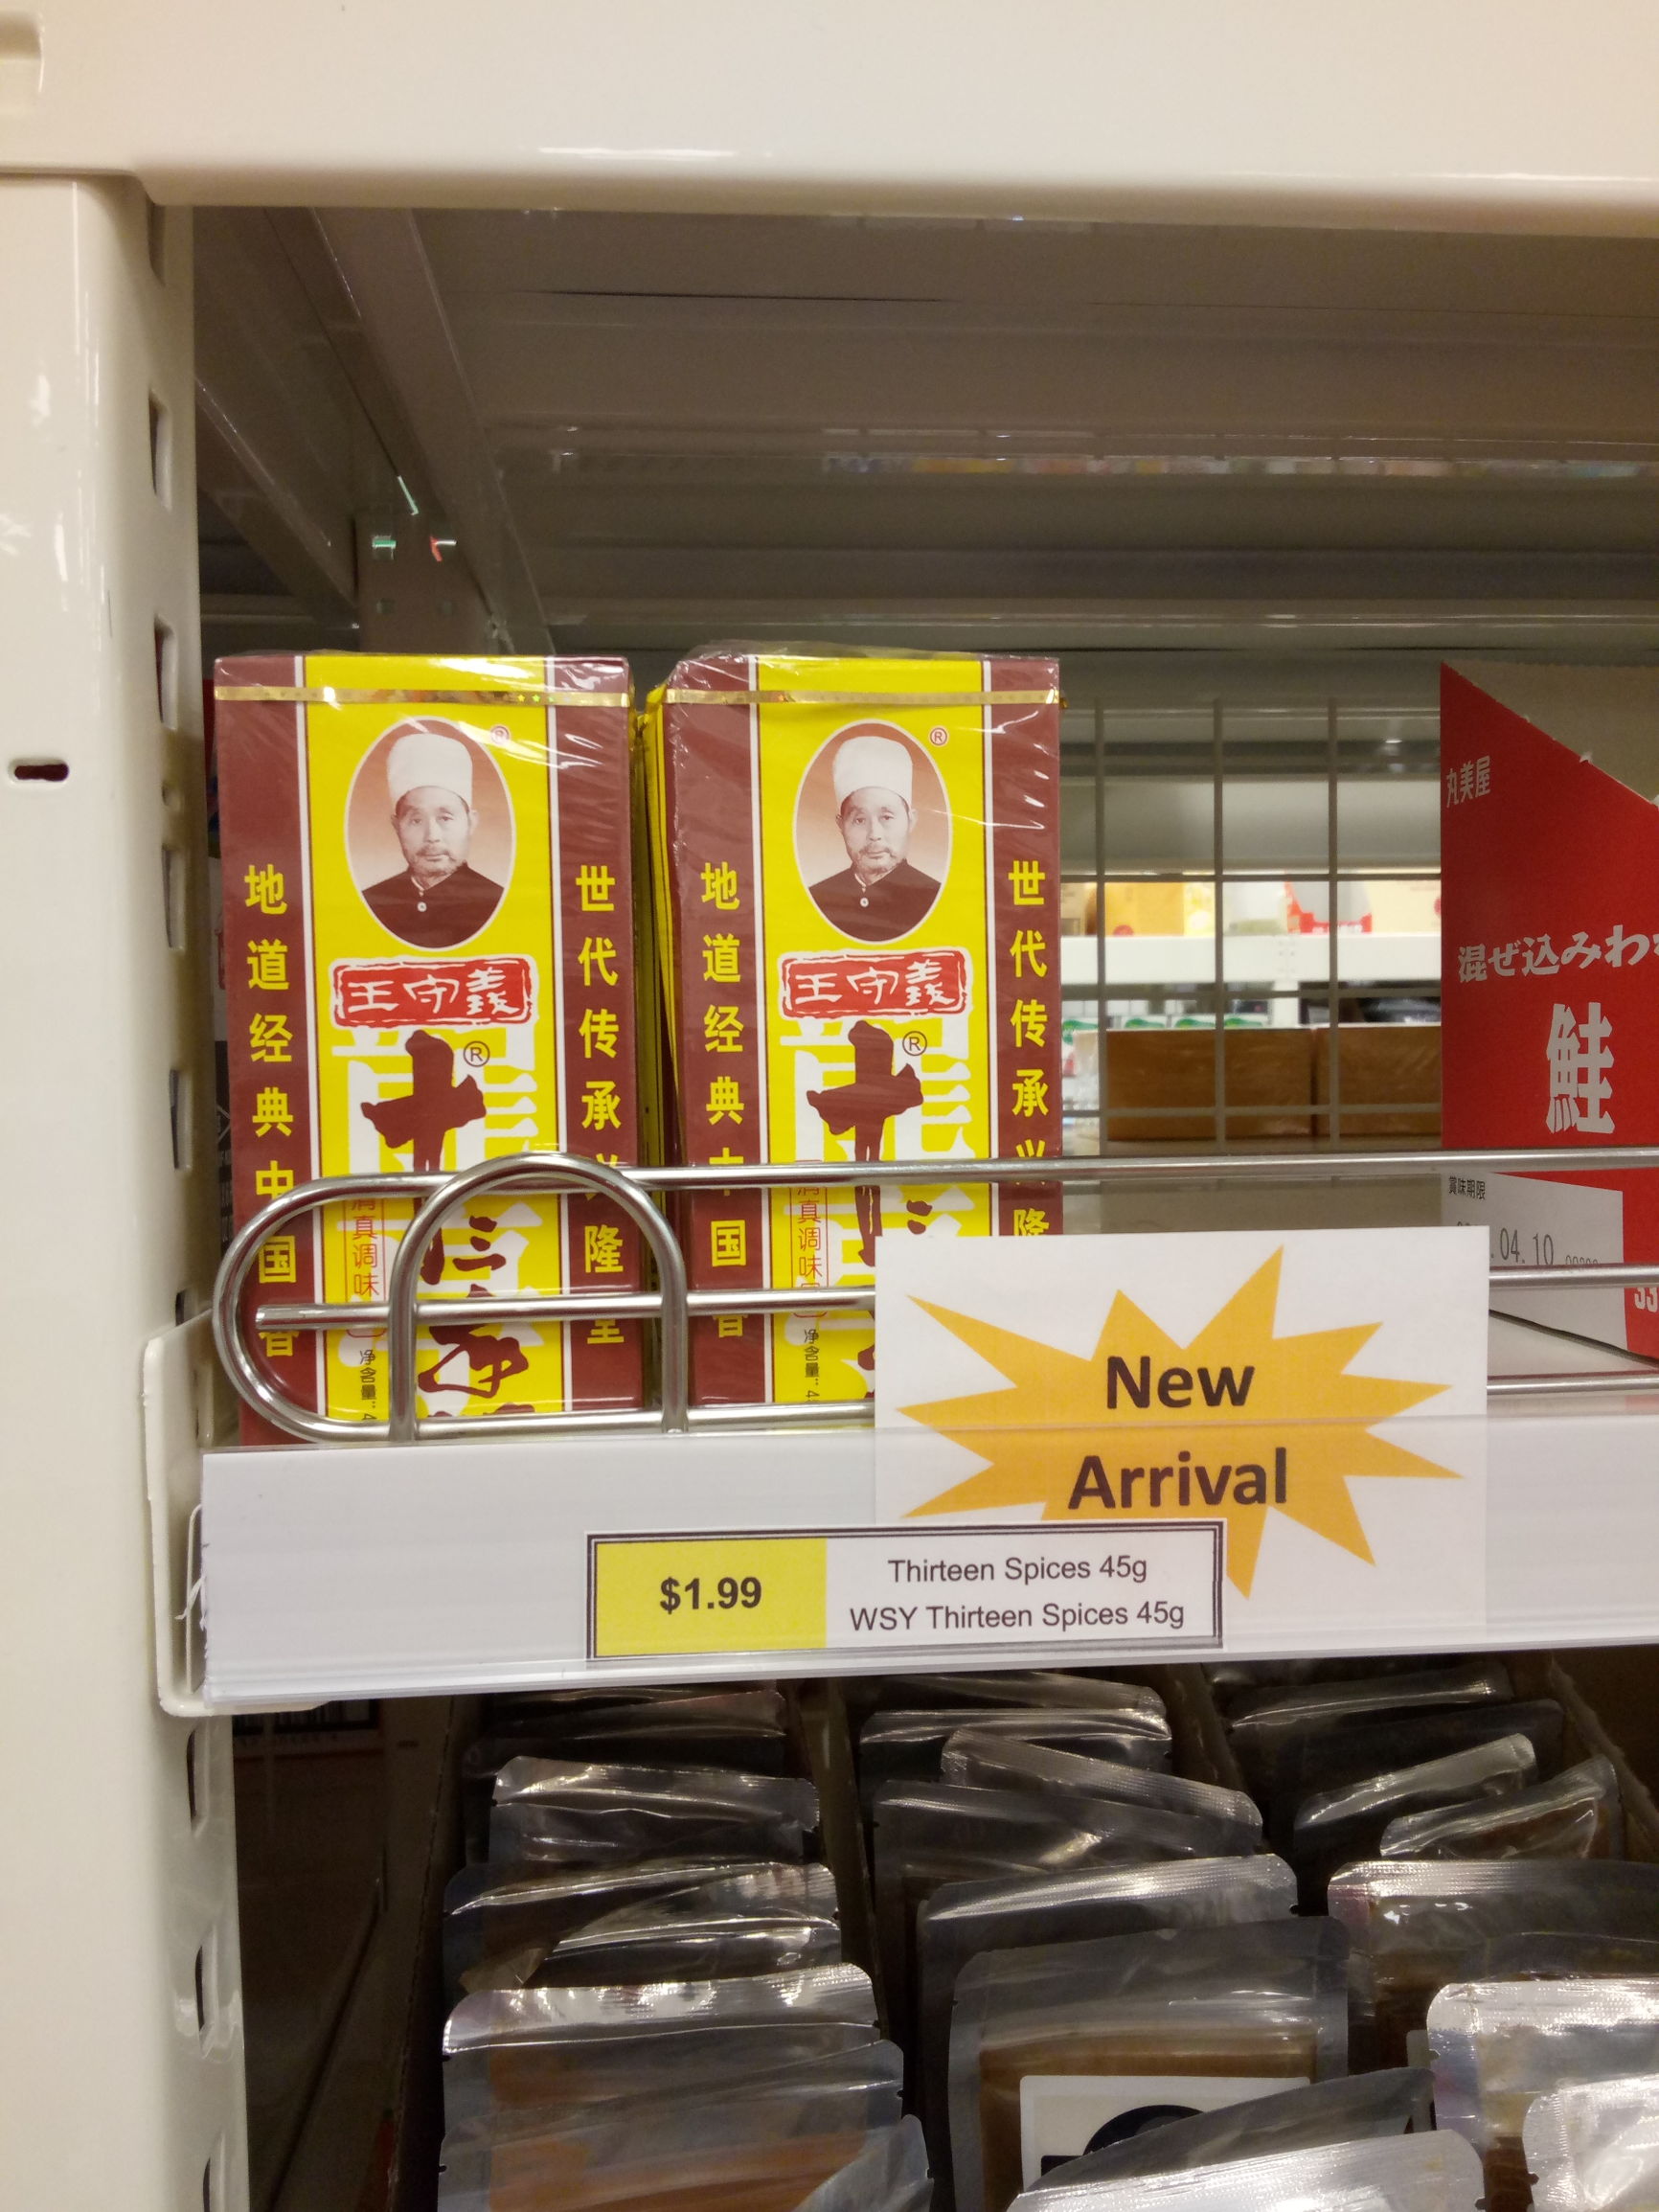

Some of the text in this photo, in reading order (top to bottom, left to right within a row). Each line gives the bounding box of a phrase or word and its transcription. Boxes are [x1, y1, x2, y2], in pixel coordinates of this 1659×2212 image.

[1445, 756, 1491, 808] 丸美屋
[1458, 924, 1659, 983] 混ぜ込みわ
[1545, 1002, 1616, 1134] 鮭
[797, 1187, 823, 1287] 真调味
[1106, 1356, 1255, 1409] New
[1068, 1447, 1286, 1510] Arrival
[659, 1576, 762, 1615] $1.99
[888, 1555, 1148, 1585] Thirteen Spices 45g
[851, 1601, 1185, 1632] WSY Thirteen Spices 45g
